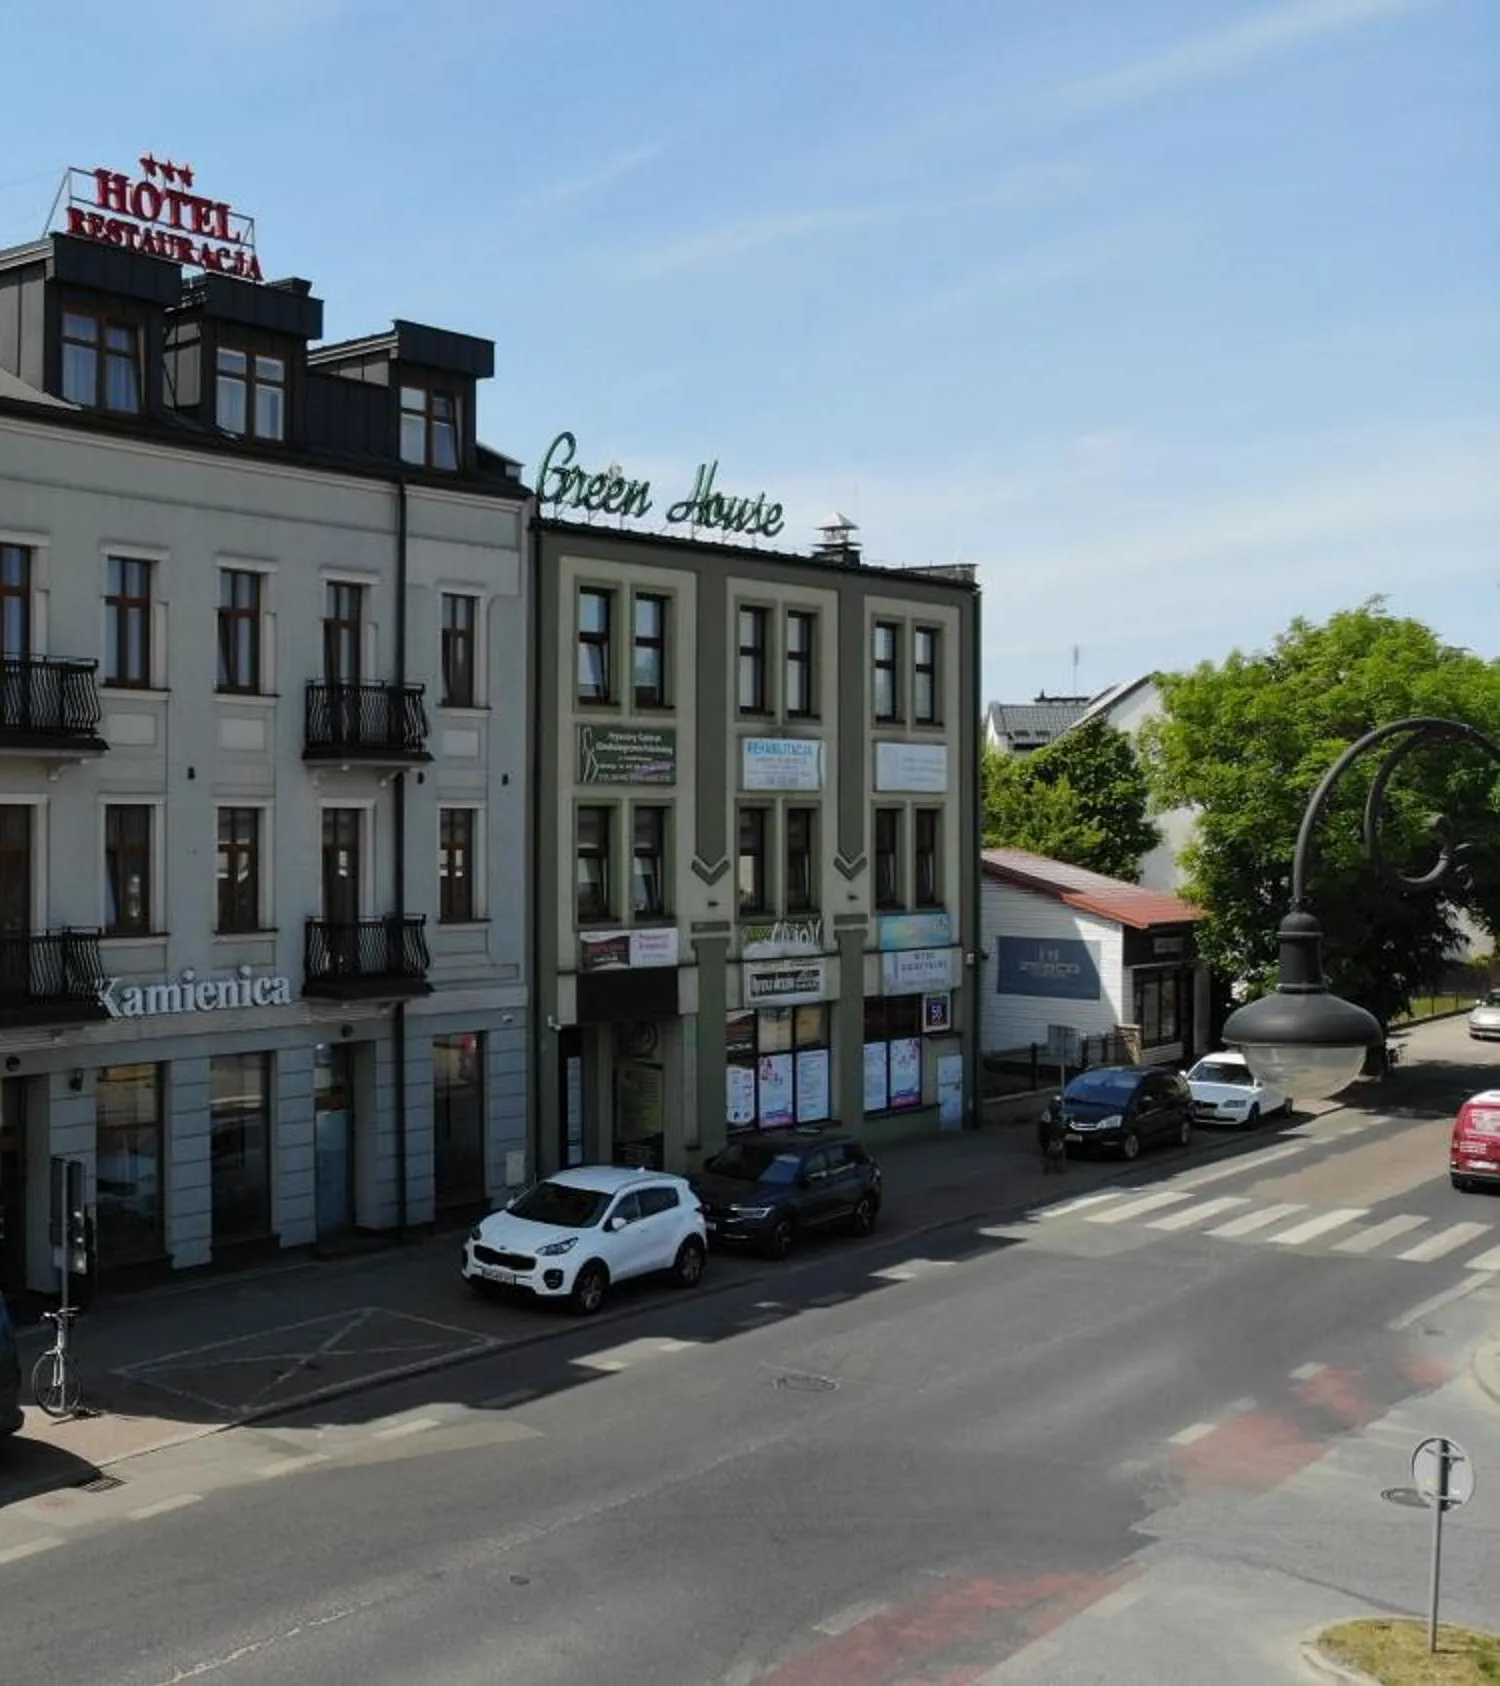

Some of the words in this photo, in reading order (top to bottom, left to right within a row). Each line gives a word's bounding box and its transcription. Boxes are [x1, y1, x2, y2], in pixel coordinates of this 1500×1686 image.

[94, 167, 241, 242] HOTEL
[66, 206, 263, 281] RESTAURACJA
[536, 431, 652, 518] Green
[666, 458, 785, 537] House
[96, 965, 292, 1017] Kamienica
